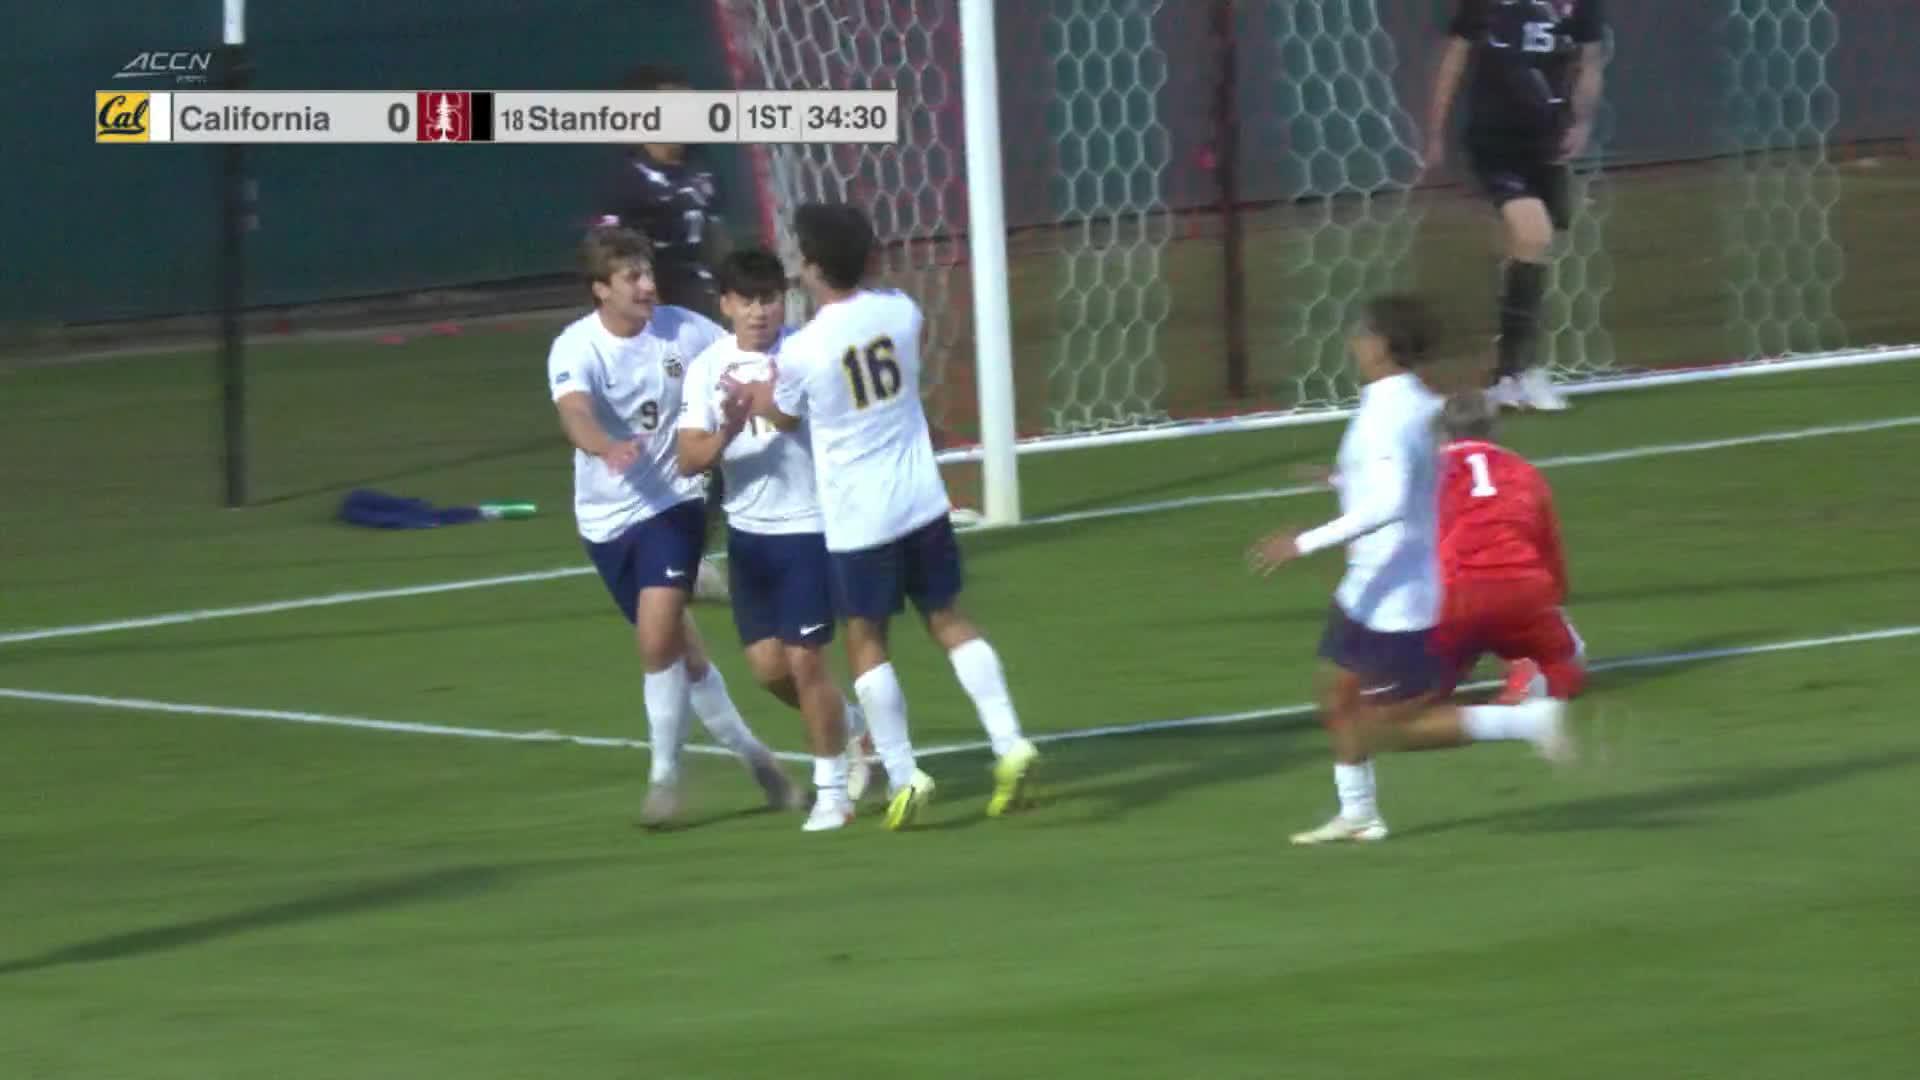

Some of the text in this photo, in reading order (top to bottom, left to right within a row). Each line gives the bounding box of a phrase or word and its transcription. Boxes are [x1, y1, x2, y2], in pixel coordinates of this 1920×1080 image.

[1522, 21, 1555, 52] 15
[842, 335, 901, 409] 16
[640, 400, 659, 430] 9
[1464, 453, 1498, 497] 1
